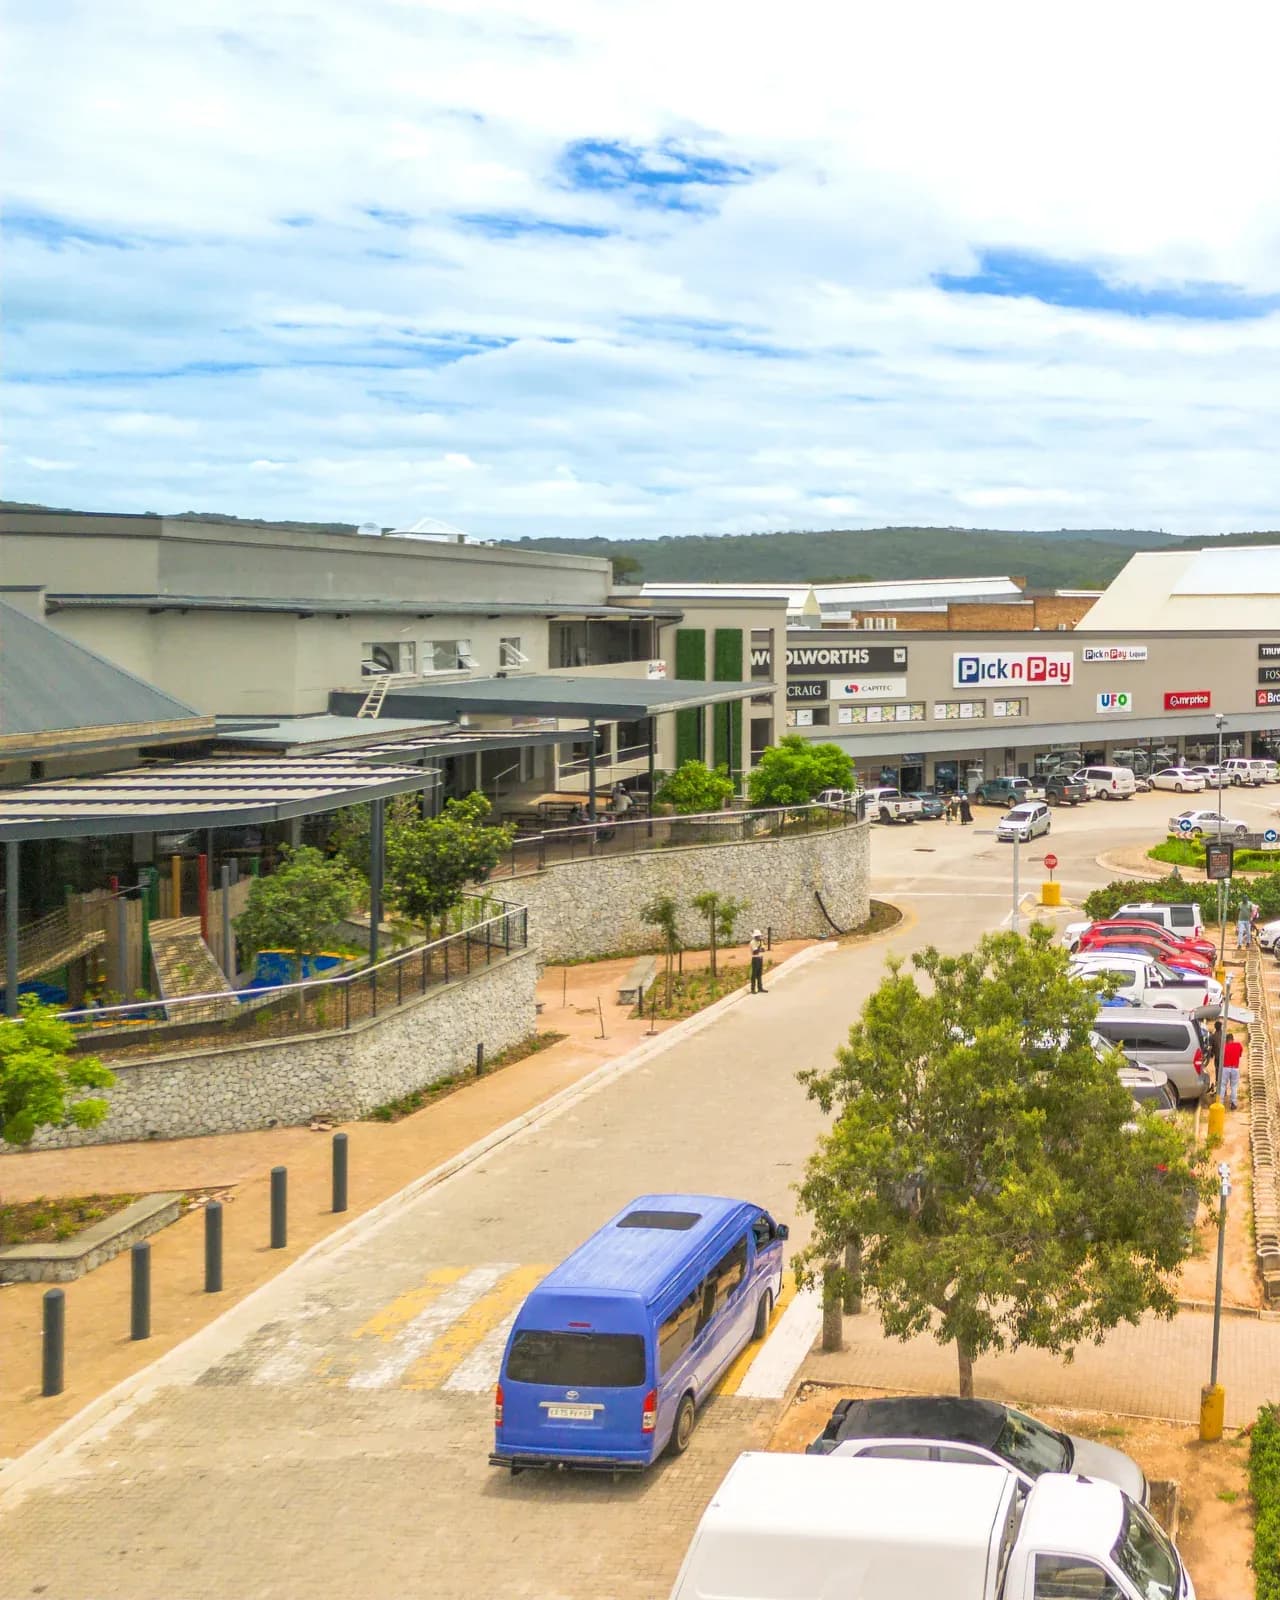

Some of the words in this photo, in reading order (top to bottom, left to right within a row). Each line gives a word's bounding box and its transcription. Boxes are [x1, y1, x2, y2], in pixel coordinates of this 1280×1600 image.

[750, 649, 869, 665] WOLWORTHS
[1085, 649, 1103, 659] Pick
[1110, 649, 1127, 660] Pay
[958, 657, 1008, 683] Pick
[1011, 663, 1023, 679] n
[1027, 656, 1071, 682] Pay
[787, 685, 821, 697] CRAIG
[1101, 694, 1128, 707] UFO
